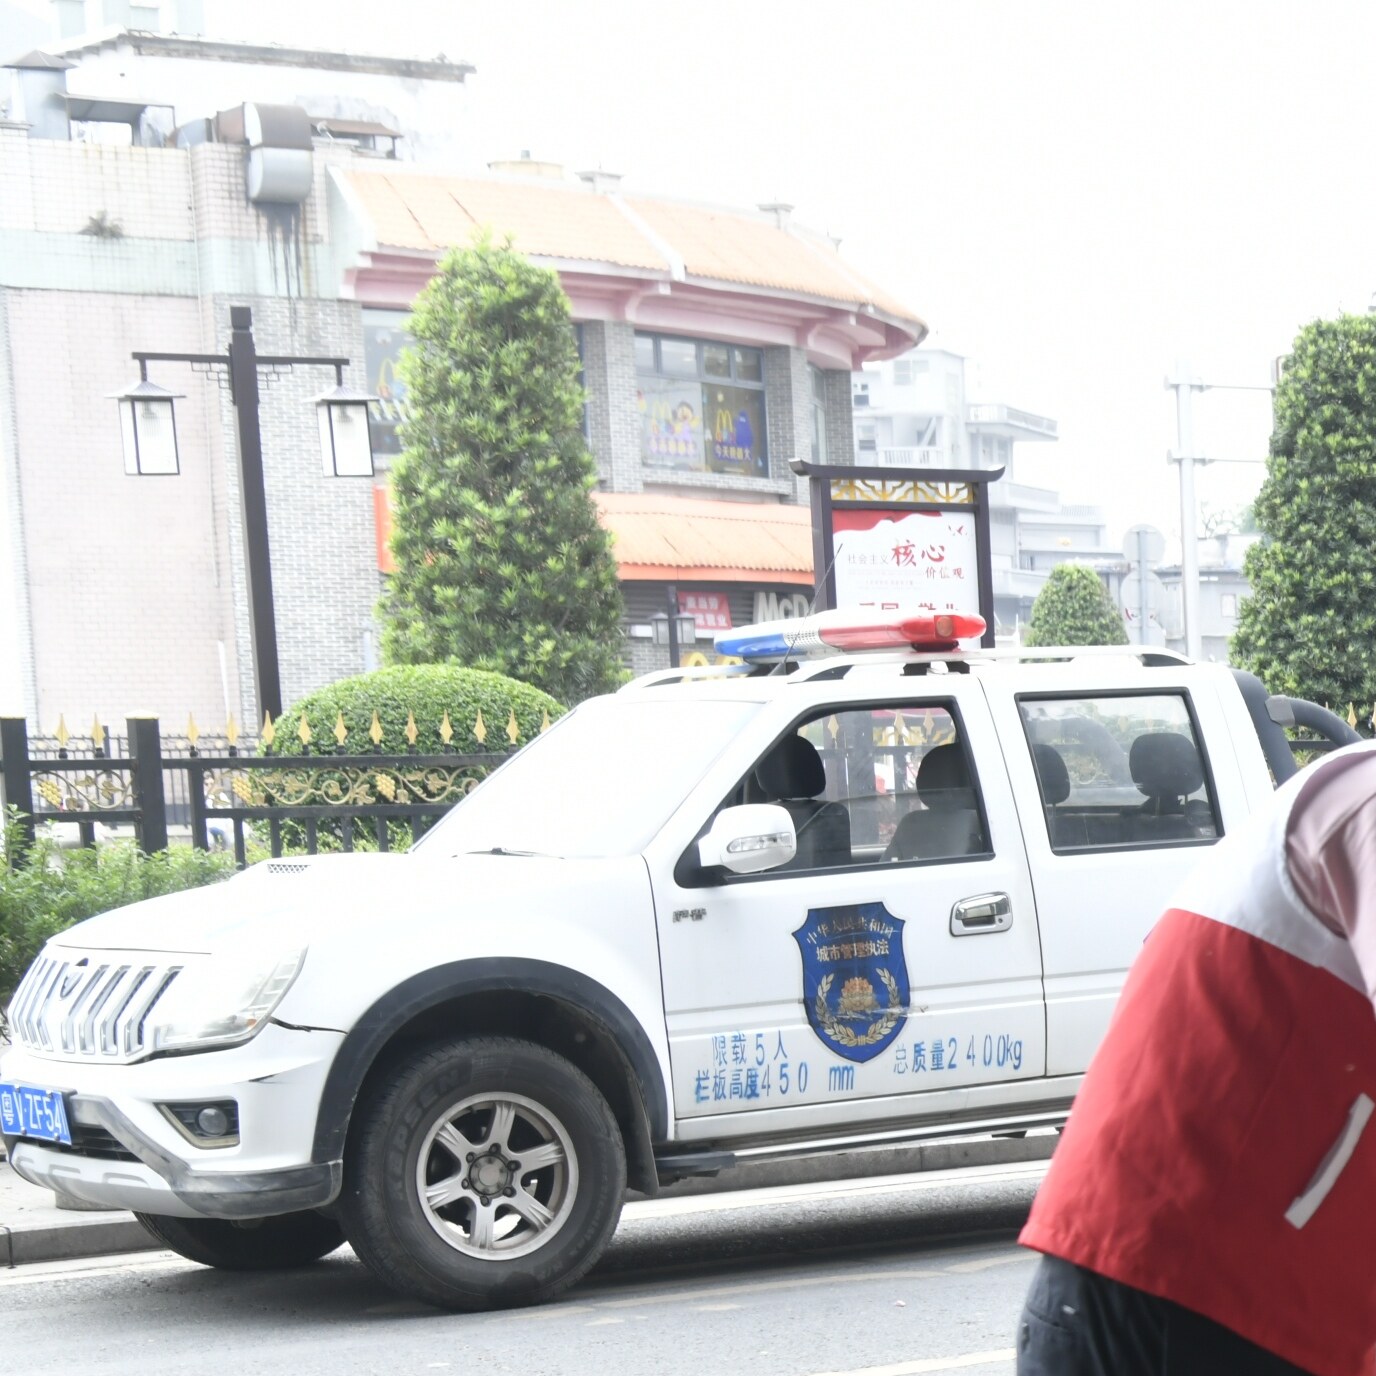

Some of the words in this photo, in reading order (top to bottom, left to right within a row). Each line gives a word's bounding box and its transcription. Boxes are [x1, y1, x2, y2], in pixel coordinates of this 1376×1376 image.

[848, 552, 890, 566] 社会主义
[891, 539, 946, 567] 核心
[806, 915, 894, 945] 中华人民共和国
[816, 938, 890, 963] 城市管理执法
